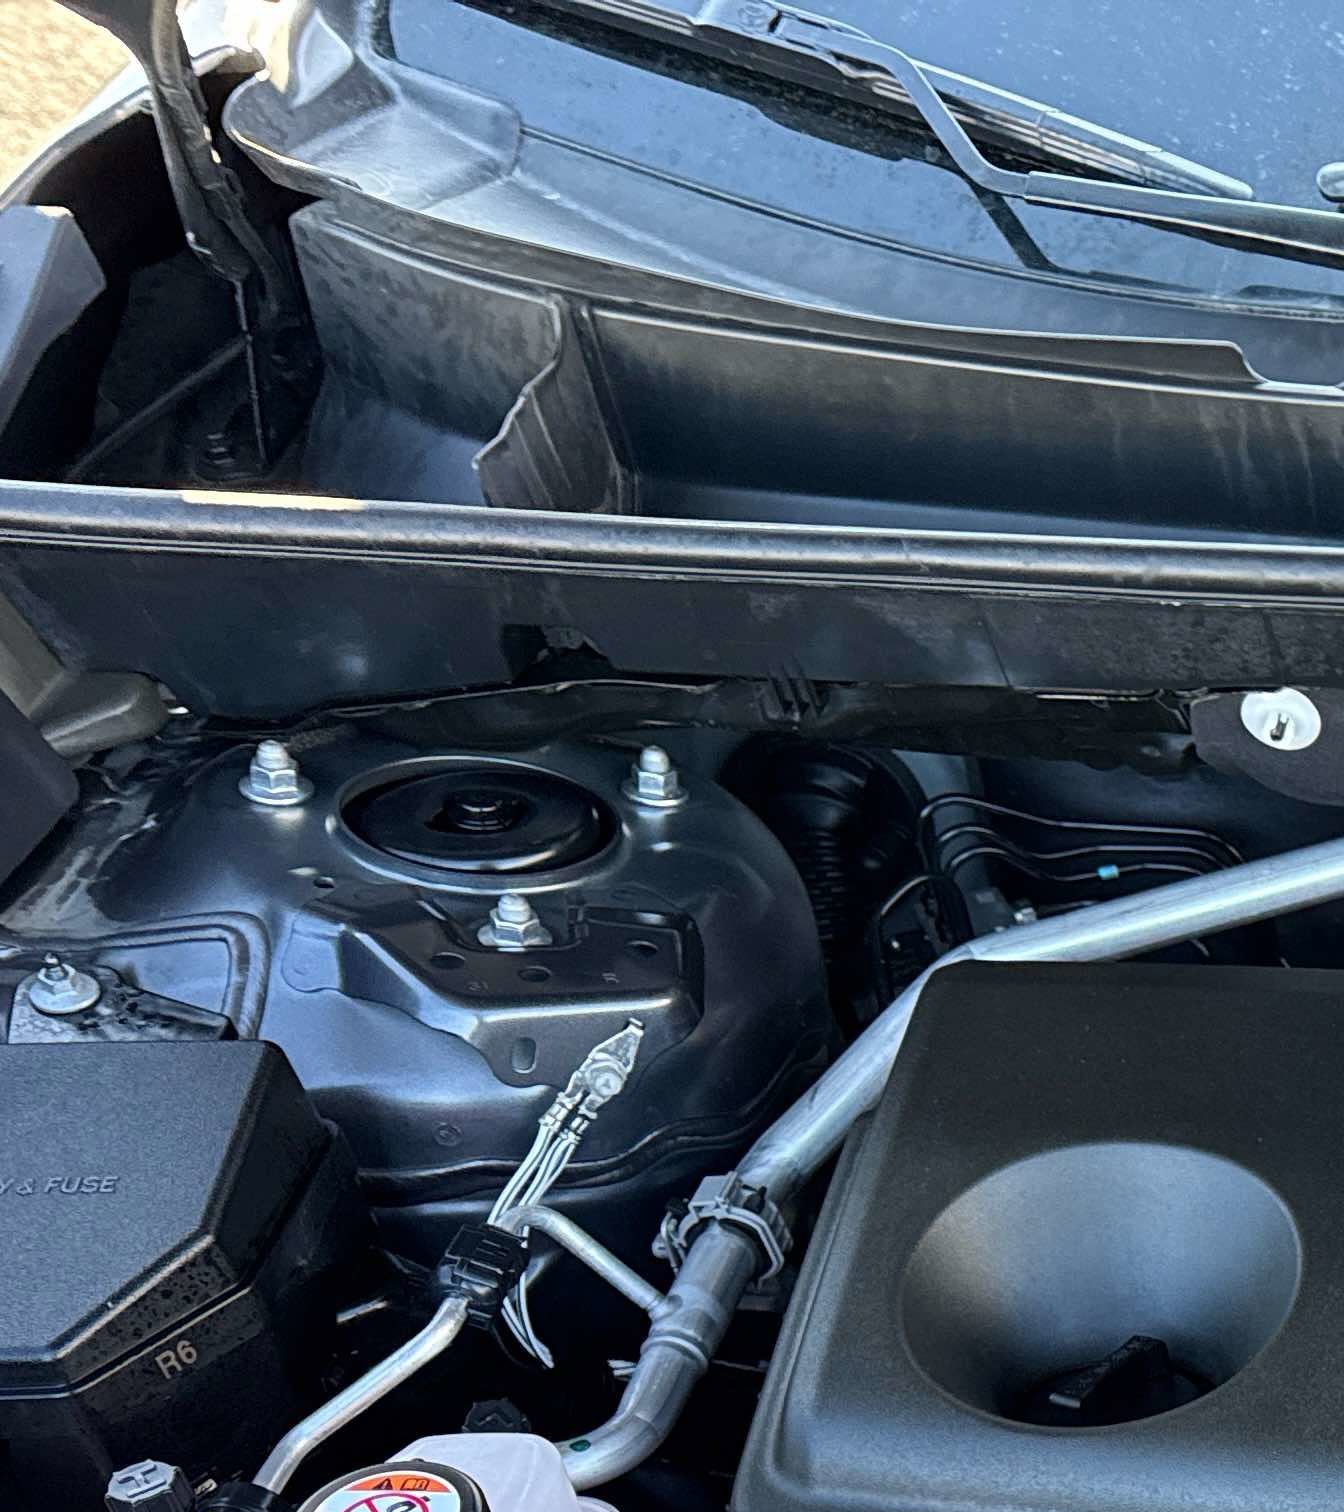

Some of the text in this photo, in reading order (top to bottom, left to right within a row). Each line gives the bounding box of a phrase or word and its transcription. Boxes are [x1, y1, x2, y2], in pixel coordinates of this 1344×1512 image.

[16, 1179, 36, 1196] &
[44, 1175, 120, 1194] FUSE
[153, 1339, 199, 1381] R6
